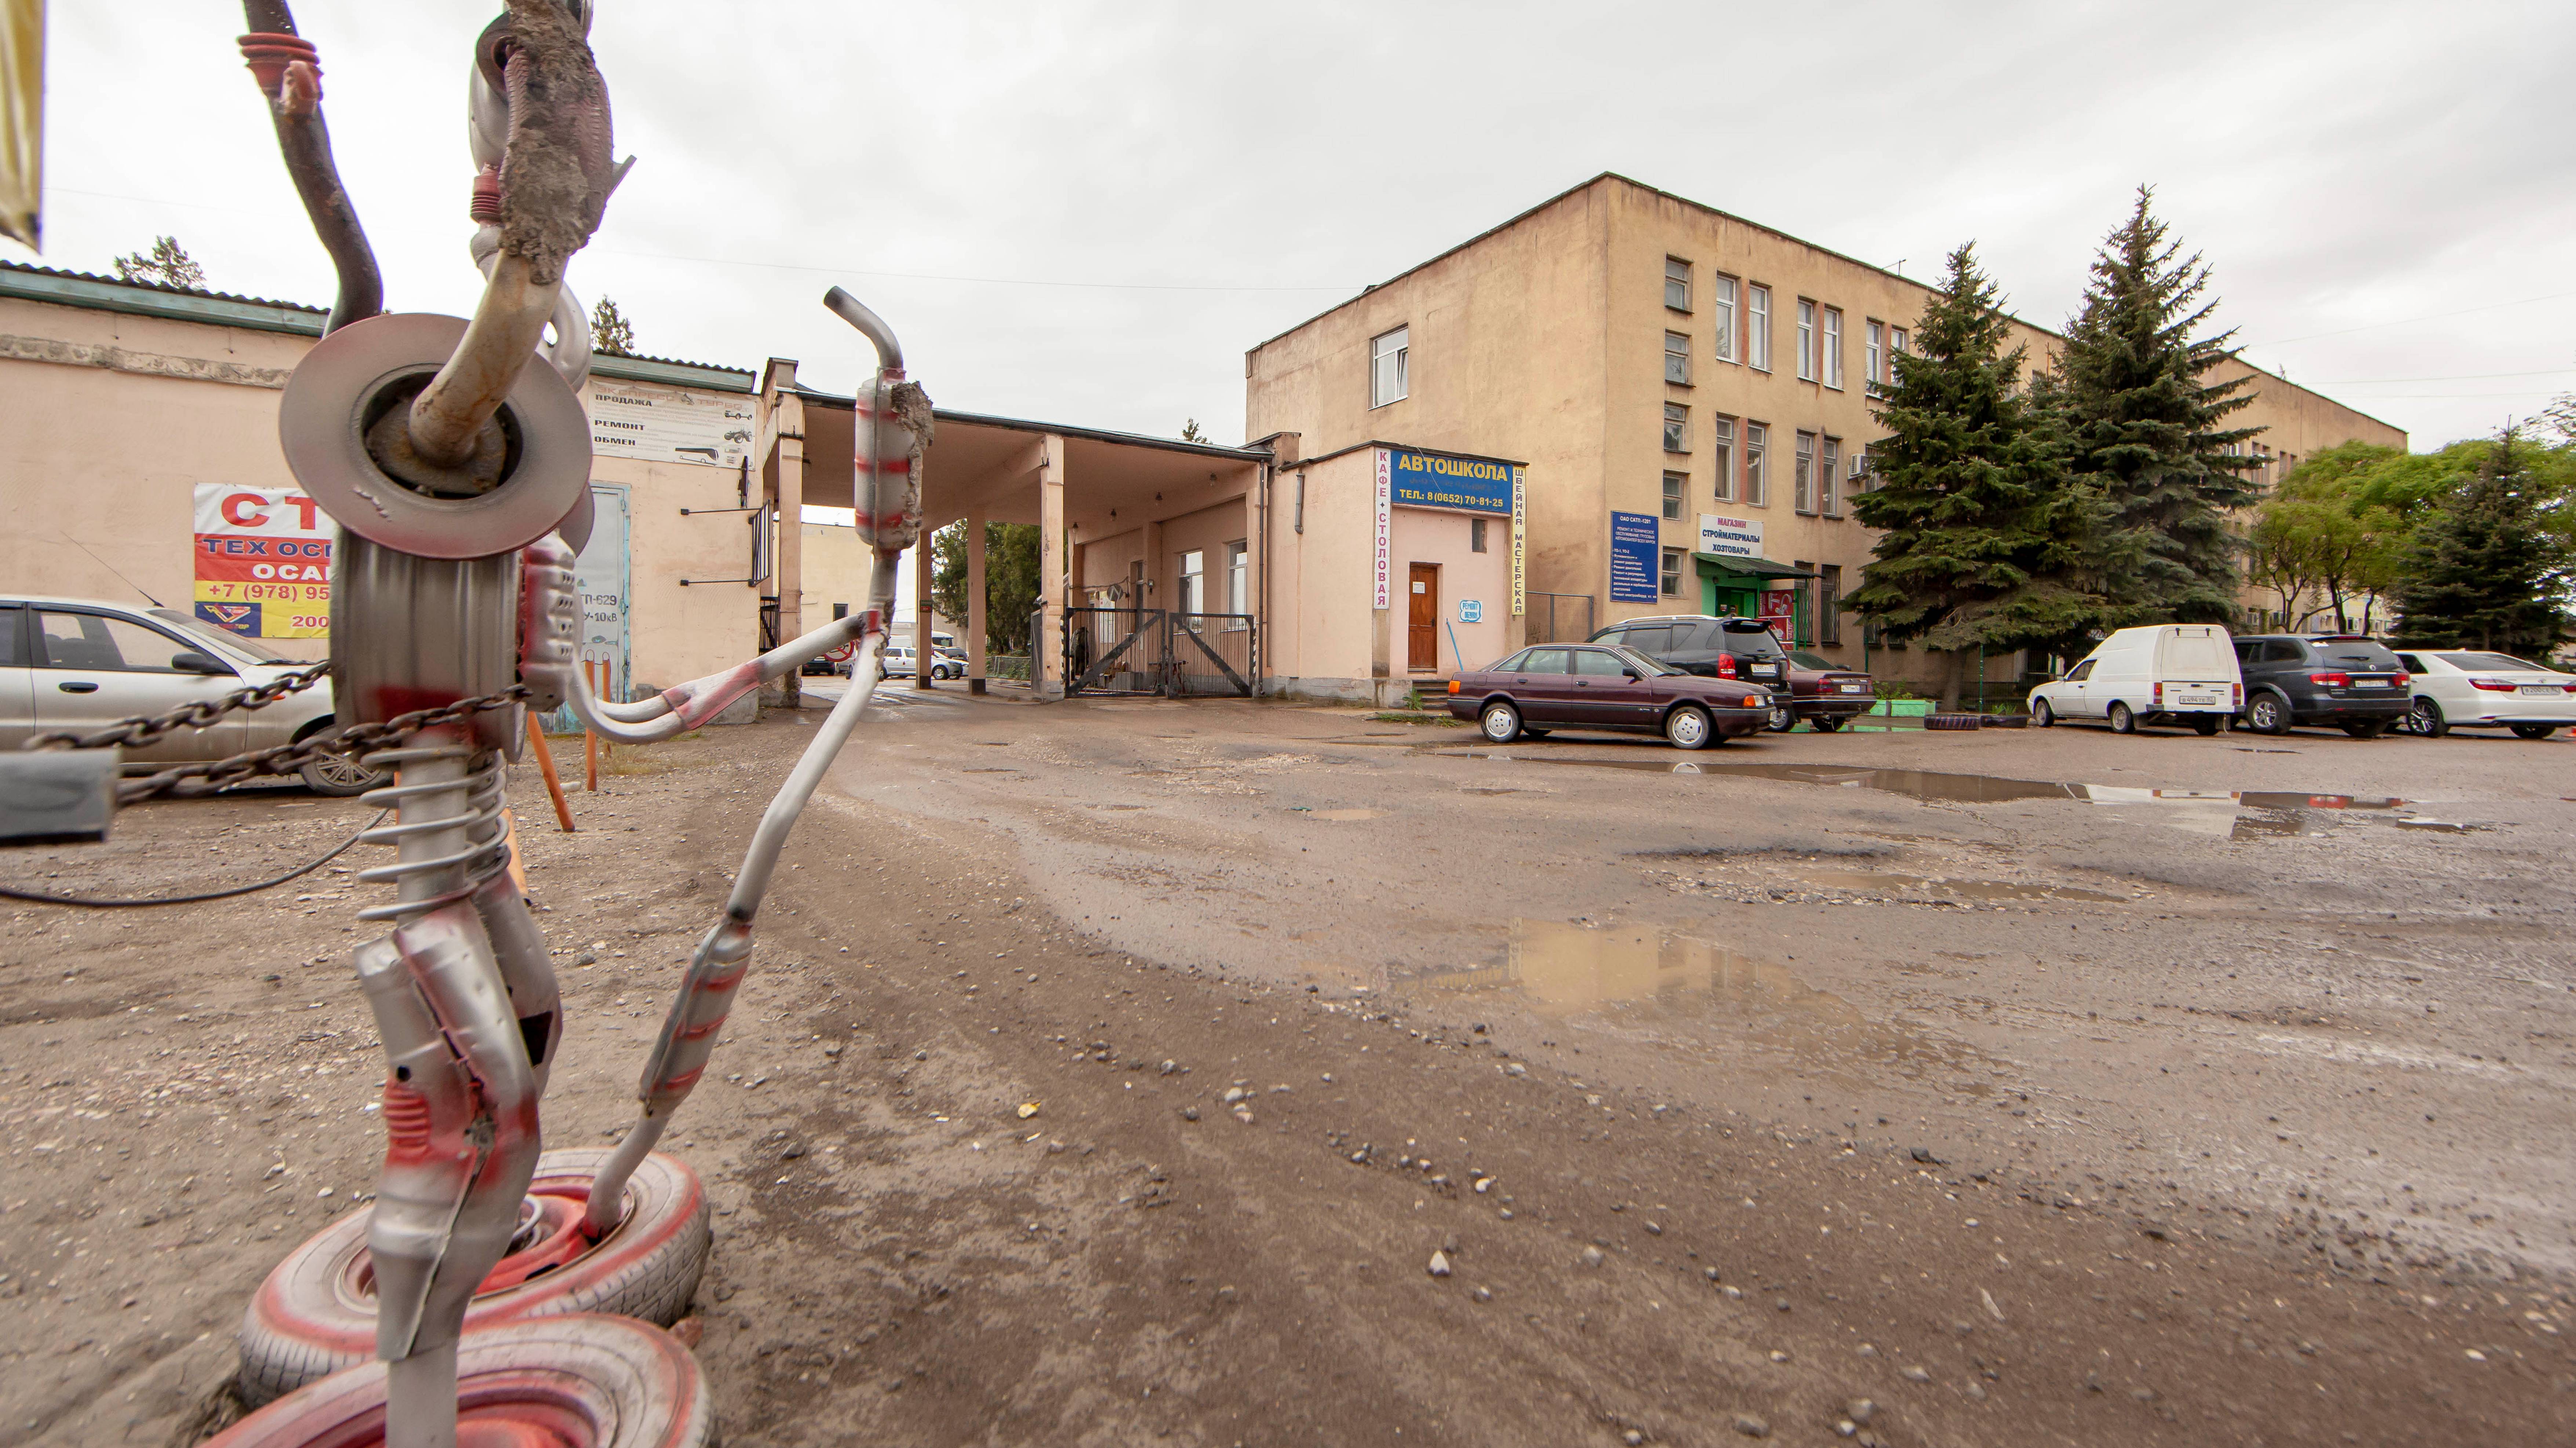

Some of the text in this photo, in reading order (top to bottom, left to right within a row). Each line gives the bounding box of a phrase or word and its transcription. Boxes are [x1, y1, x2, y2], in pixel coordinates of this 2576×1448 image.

[596, 394, 652, 407] ПРОДАЖА
[598, 387, 675, 401] ЭКСПРЕСС
[595, 420, 645, 431] РЕМОНТ
[594, 436, 635, 446] ОБМЕН
[1398, 454, 1508, 482] АВТОШКОЛА
[1465, 496, 1503, 507] 70-81-25
[1378, 451, 1387, 605] КАФЕ СТОЛОВАЯ
[1717, 518, 1746, 529] МАГАЗИН
[1514, 469, 1523, 613] ШВЕЙНАЯ МАСТЕРСКАЯ
[1702, 529, 1760, 543] СТРОЙМАТЕРИАЛЫ
[203, 538, 269, 556] ТЕХ
[1712, 544, 1750, 555] ХОЗТОВАРЫ
[209, 584, 235, 597] +7
[244, 584, 298, 602] (978)
